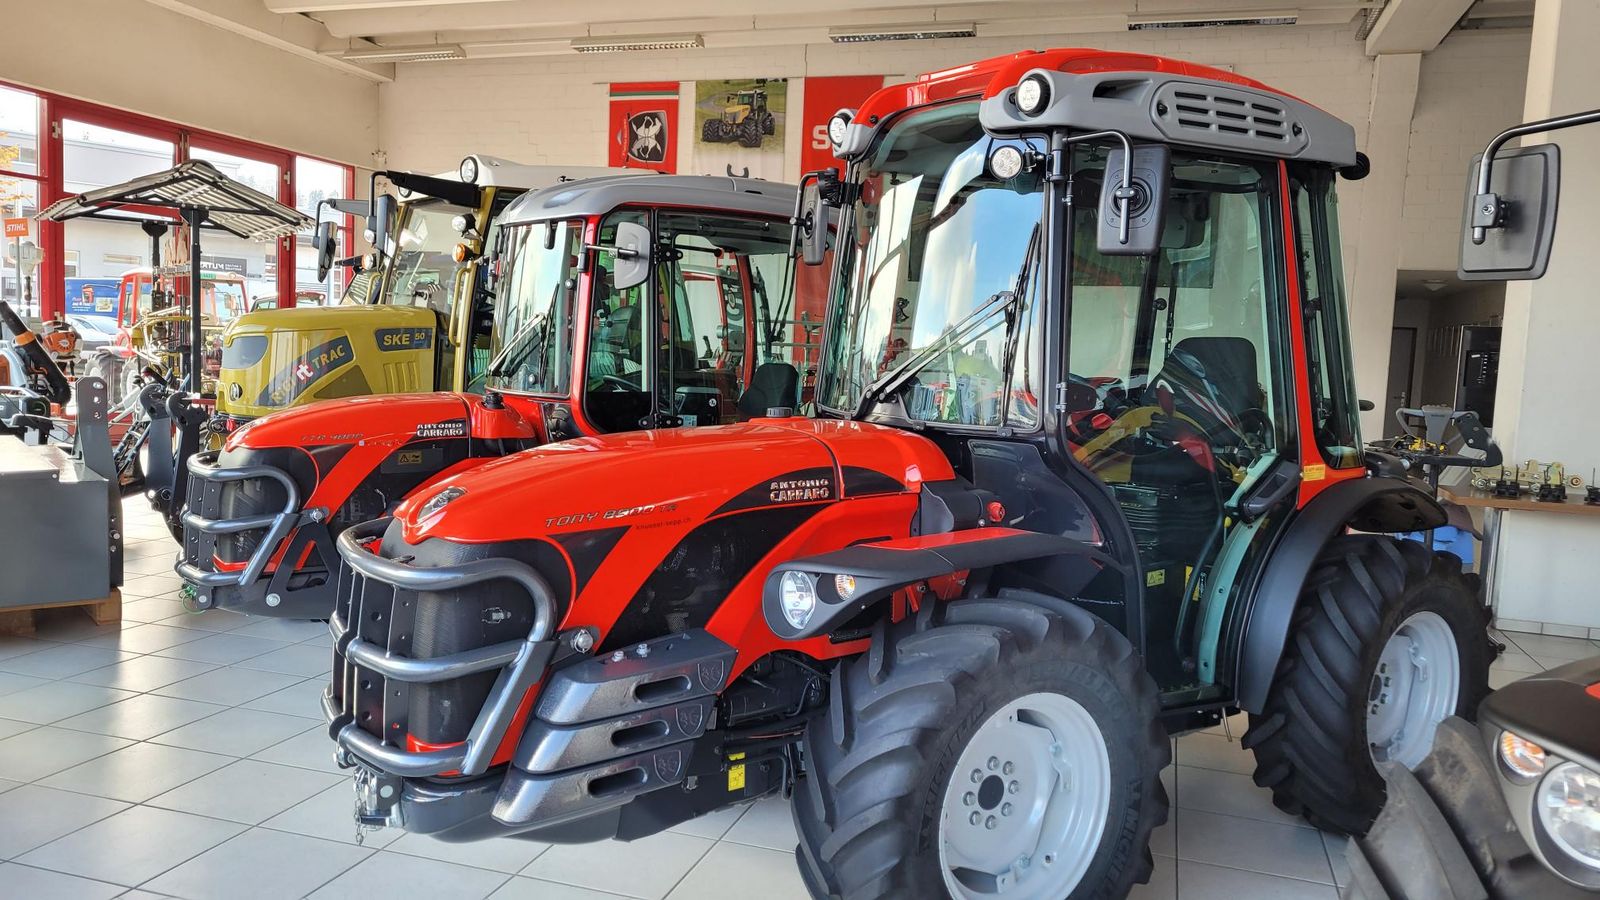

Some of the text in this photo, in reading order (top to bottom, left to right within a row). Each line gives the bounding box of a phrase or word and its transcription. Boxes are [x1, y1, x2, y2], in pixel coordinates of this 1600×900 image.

[6, 224, 26, 232] STIHL
[383, 334, 410, 346] SKE
[312, 345, 345, 369] TRAC
[416, 429, 463, 437] CARRARO
[770, 478, 829, 490] ANTONIO
[770, 487, 830, 502] CARRARO
[545, 511, 599, 527] TONY
